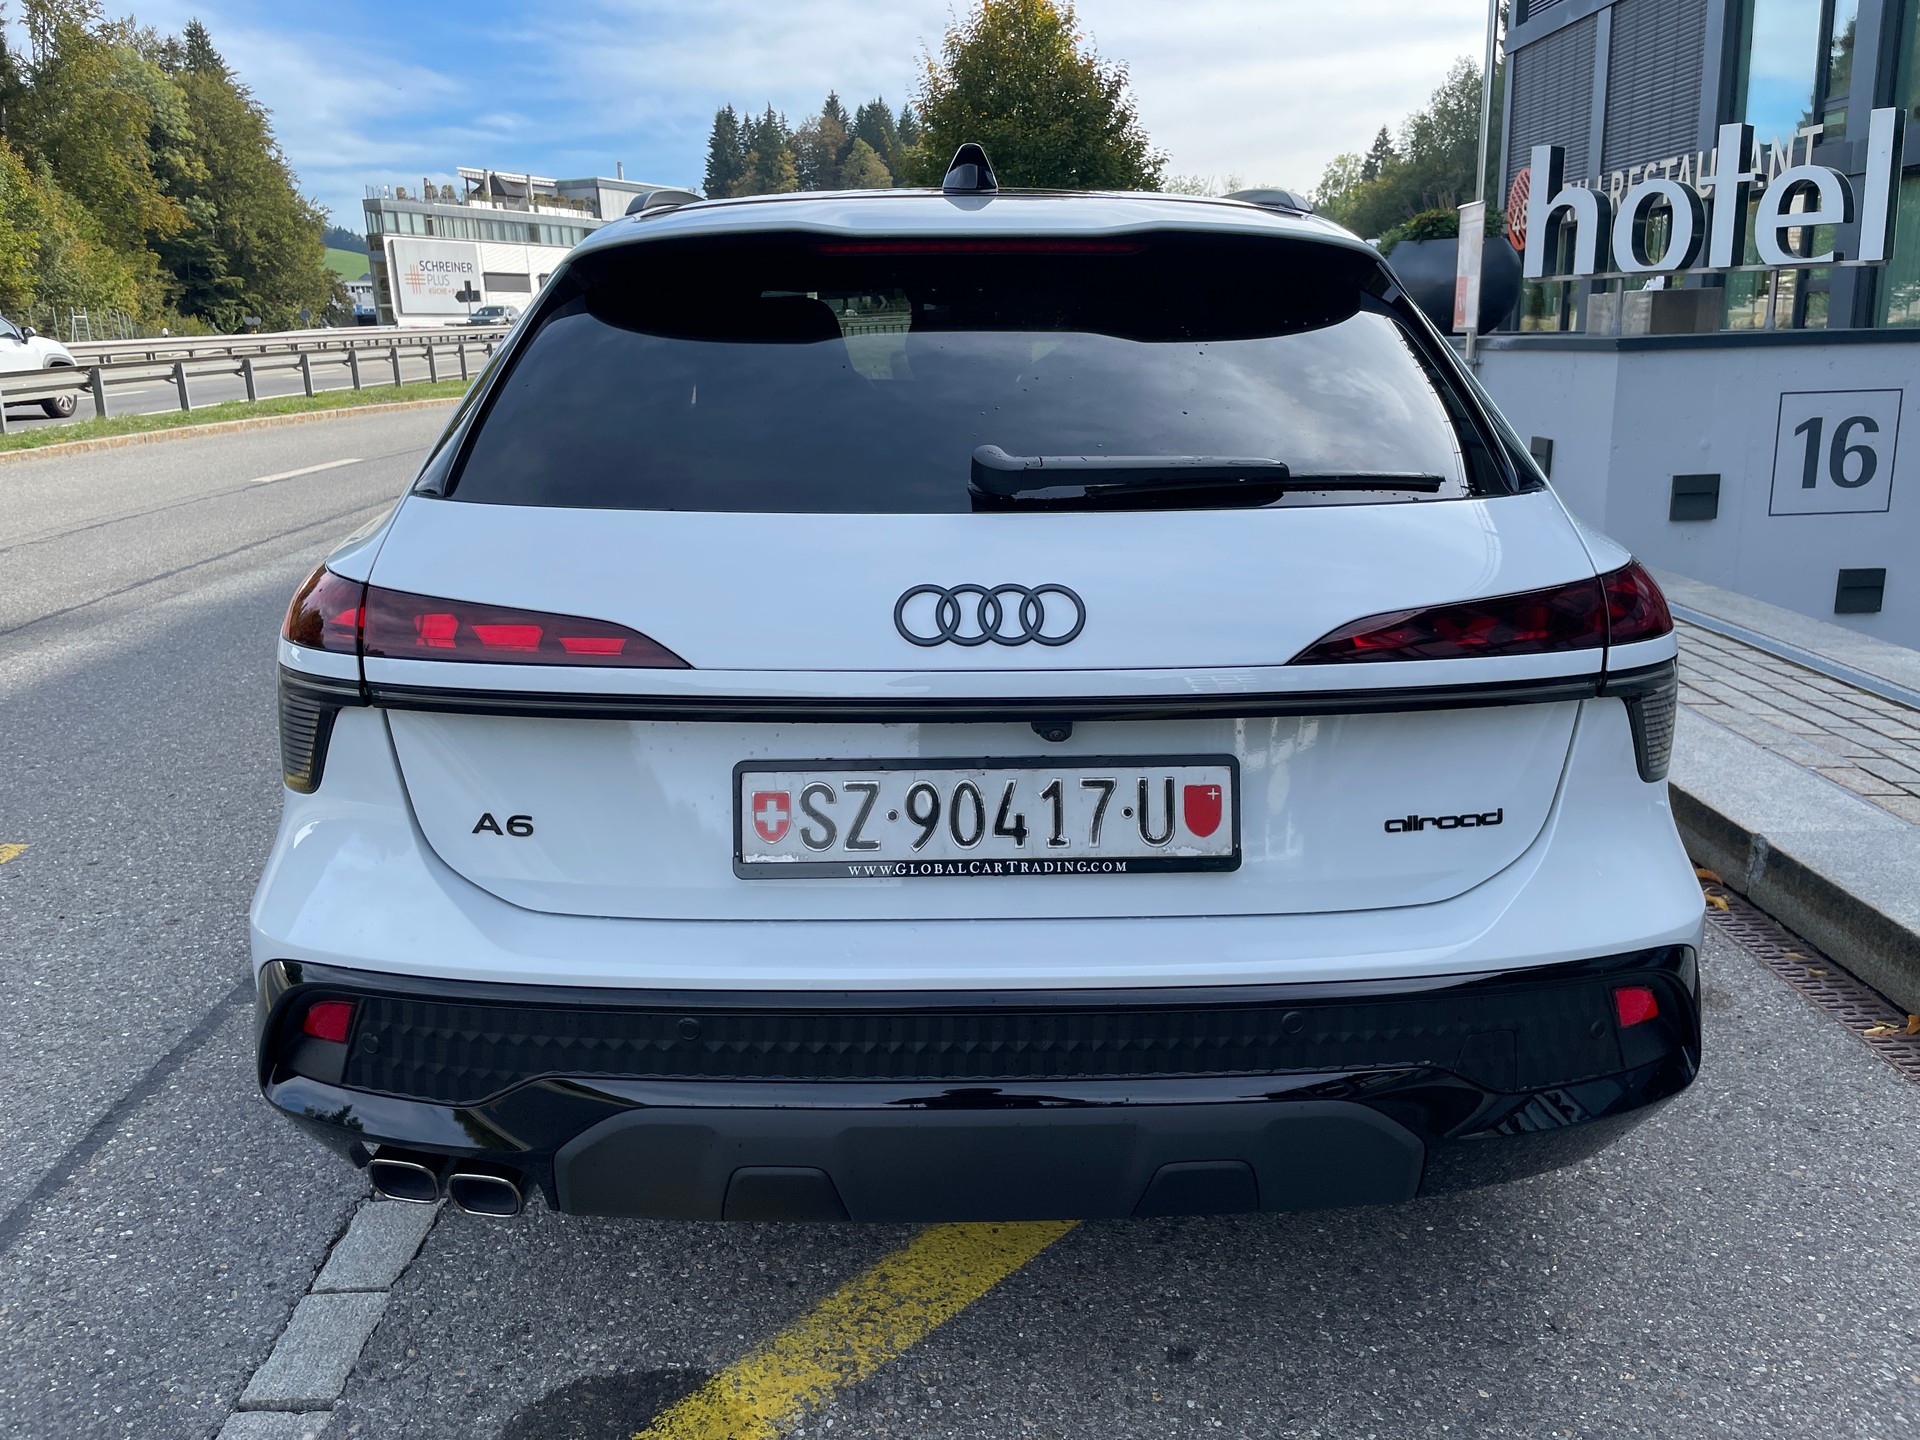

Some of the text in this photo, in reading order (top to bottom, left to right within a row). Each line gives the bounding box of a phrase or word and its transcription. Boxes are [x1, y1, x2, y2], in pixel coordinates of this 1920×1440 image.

[1608, 124, 1824, 210] RETAUANT
[1523, 107, 1905, 279] hotel
[419, 260, 473, 274] SCHREINER
[427, 274, 450, 287] PLUS
[1794, 416, 1879, 489] 16
[471, 812, 534, 837] A6
[1384, 807, 1503, 833] allroad
